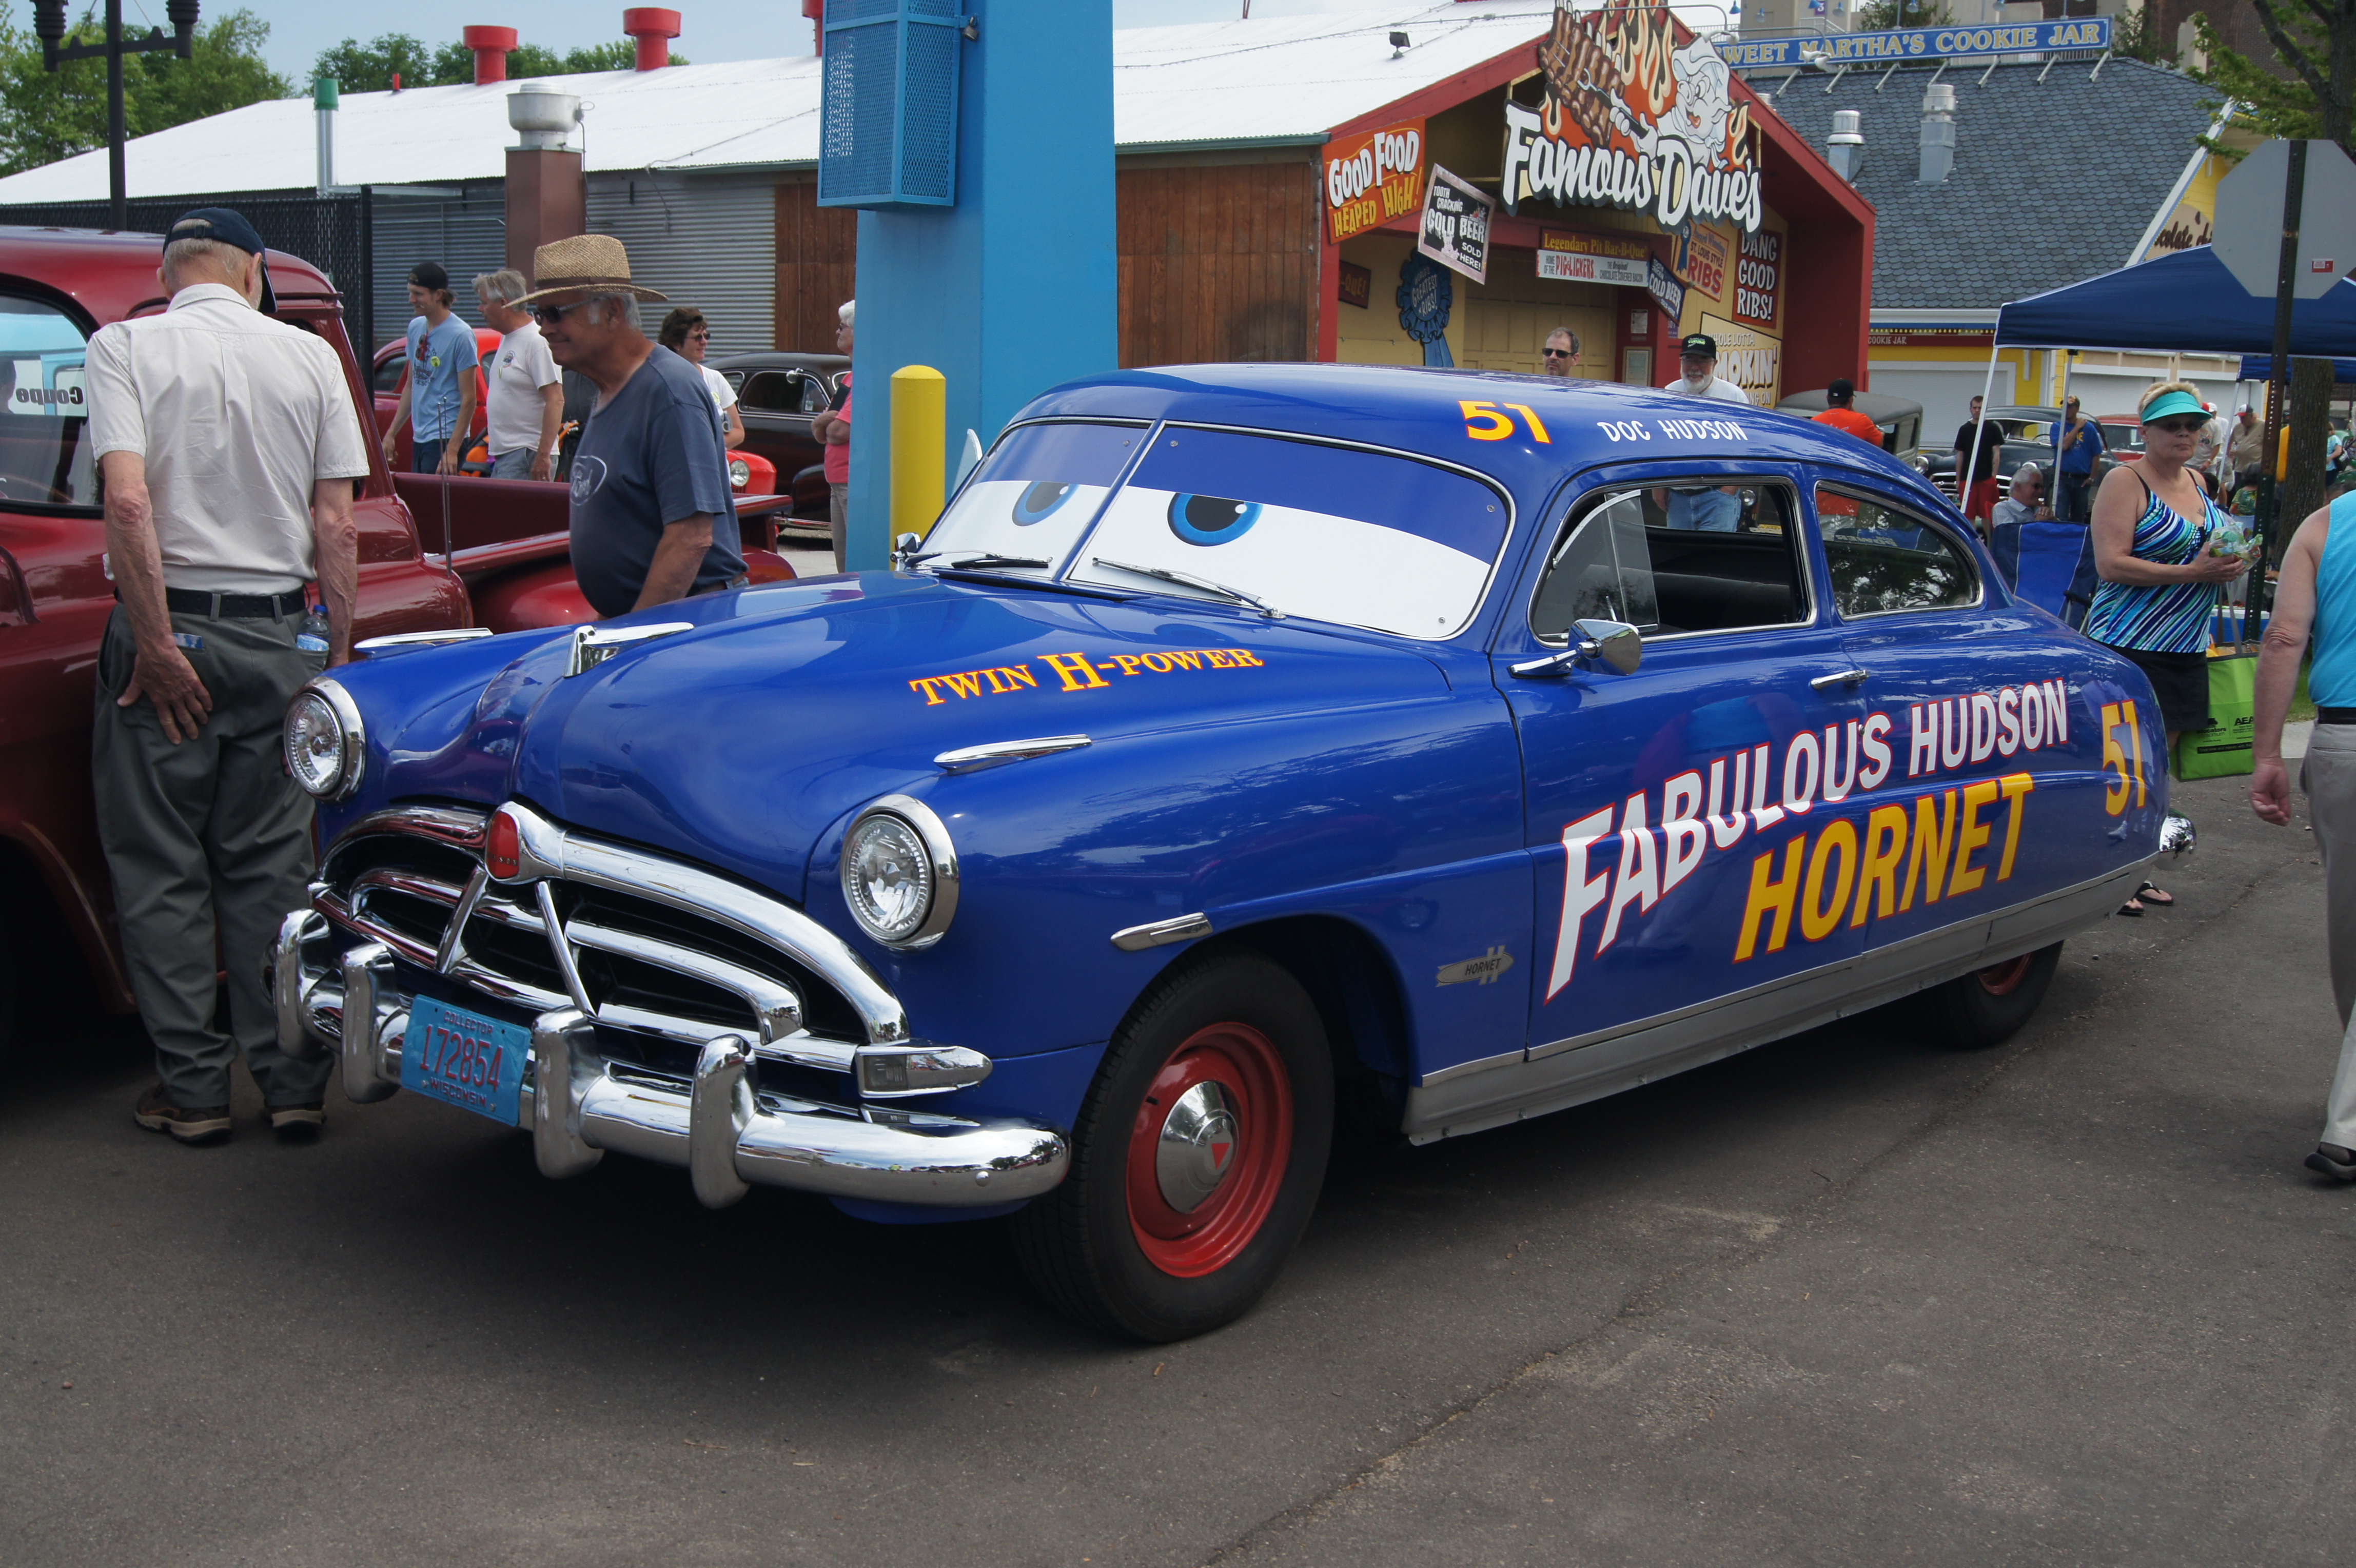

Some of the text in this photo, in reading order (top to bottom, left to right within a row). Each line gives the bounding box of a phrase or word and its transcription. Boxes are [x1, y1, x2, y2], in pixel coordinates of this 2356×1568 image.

[1715, 43, 1789, 65] WEET
[1936, 27, 2037, 52] COOKIE
[2048, 24, 2100, 46] JAR
[1328, 131, 1419, 207] GOOD FOOD
[1502, 104, 1761, 233] Famous Dave's
[1434, 186, 1450, 199] TOOTH
[1437, 197, 1463, 212] CRACKING
[1333, 200, 1376, 237] HEAPED
[1460, 217, 1486, 243] BEER
[1462, 242, 1482, 258] SOLD
[1544, 233, 1589, 254] Legendary
[1591, 239, 1602, 253] Pit
[1697, 245, 1710, 261] LOUIS
[1711, 252, 1724, 268] STYLE
[1741, 229, 1777, 262] DANG
[1460, 254, 1481, 270] HERE!
[1687, 254, 1723, 294] RIBS
[1739, 259, 1775, 290] GOOD
[1412, 274, 1438, 308] GREATEST
[1422, 289, 1438, 317] RIBS!
[1650, 273, 1681, 315] COLD BEER
[1737, 288, 1773, 320] RIBS!
[1733, 333, 1755, 346] LOTTA
[1868, 336, 1907, 345] COOKIE JAR
[1715, 344, 1777, 389] MOKIN'
[1762, 392, 1771, 405] ON
[1457, 400, 1553, 444] 51
[1597, 420, 1749, 442] DOC HUDSON
[909, 648, 1264, 706] TWIN H-POWER
[2100, 699, 2147, 818] 51
[1544, 677, 2069, 1005] FABULOUS HUDSON
[1733, 770, 2034, 965] HORNET
[1465, 958, 1502, 976] HORNET
[444, 1011, 494, 1035] COLLECTOR
[420, 1024, 504, 1092] 172854
[430, 1076, 487, 1107] WISCONSIN
